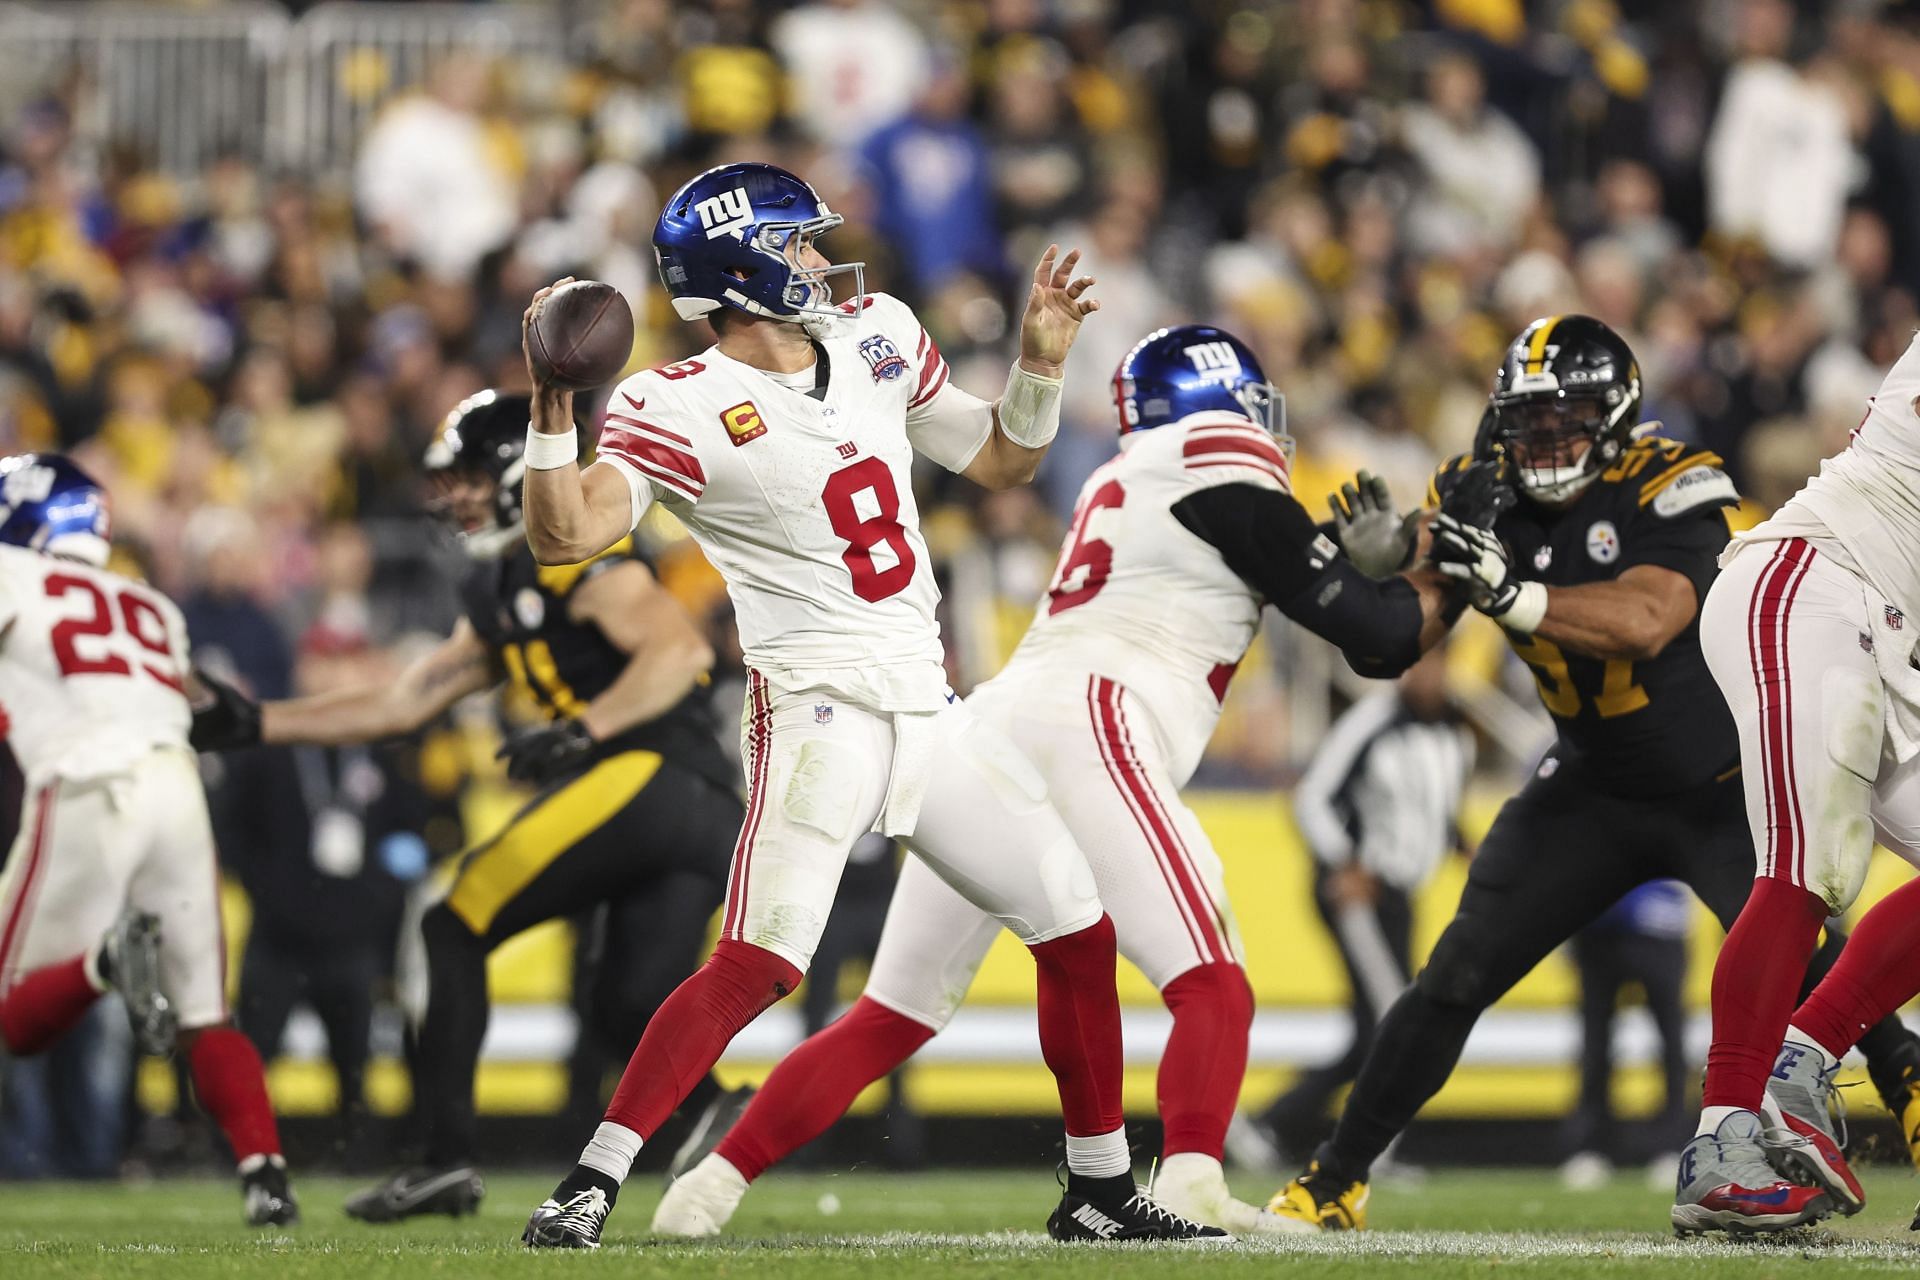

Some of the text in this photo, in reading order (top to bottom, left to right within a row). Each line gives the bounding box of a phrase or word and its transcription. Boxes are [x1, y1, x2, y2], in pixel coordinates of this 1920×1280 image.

[860, 340, 899, 371] 100
[725, 404, 760, 435] C
[821, 455, 917, 604] 8
[1049, 479, 1127, 617] 6
[44, 572, 188, 694] 29
[1071, 1203, 1124, 1239] NIKE
